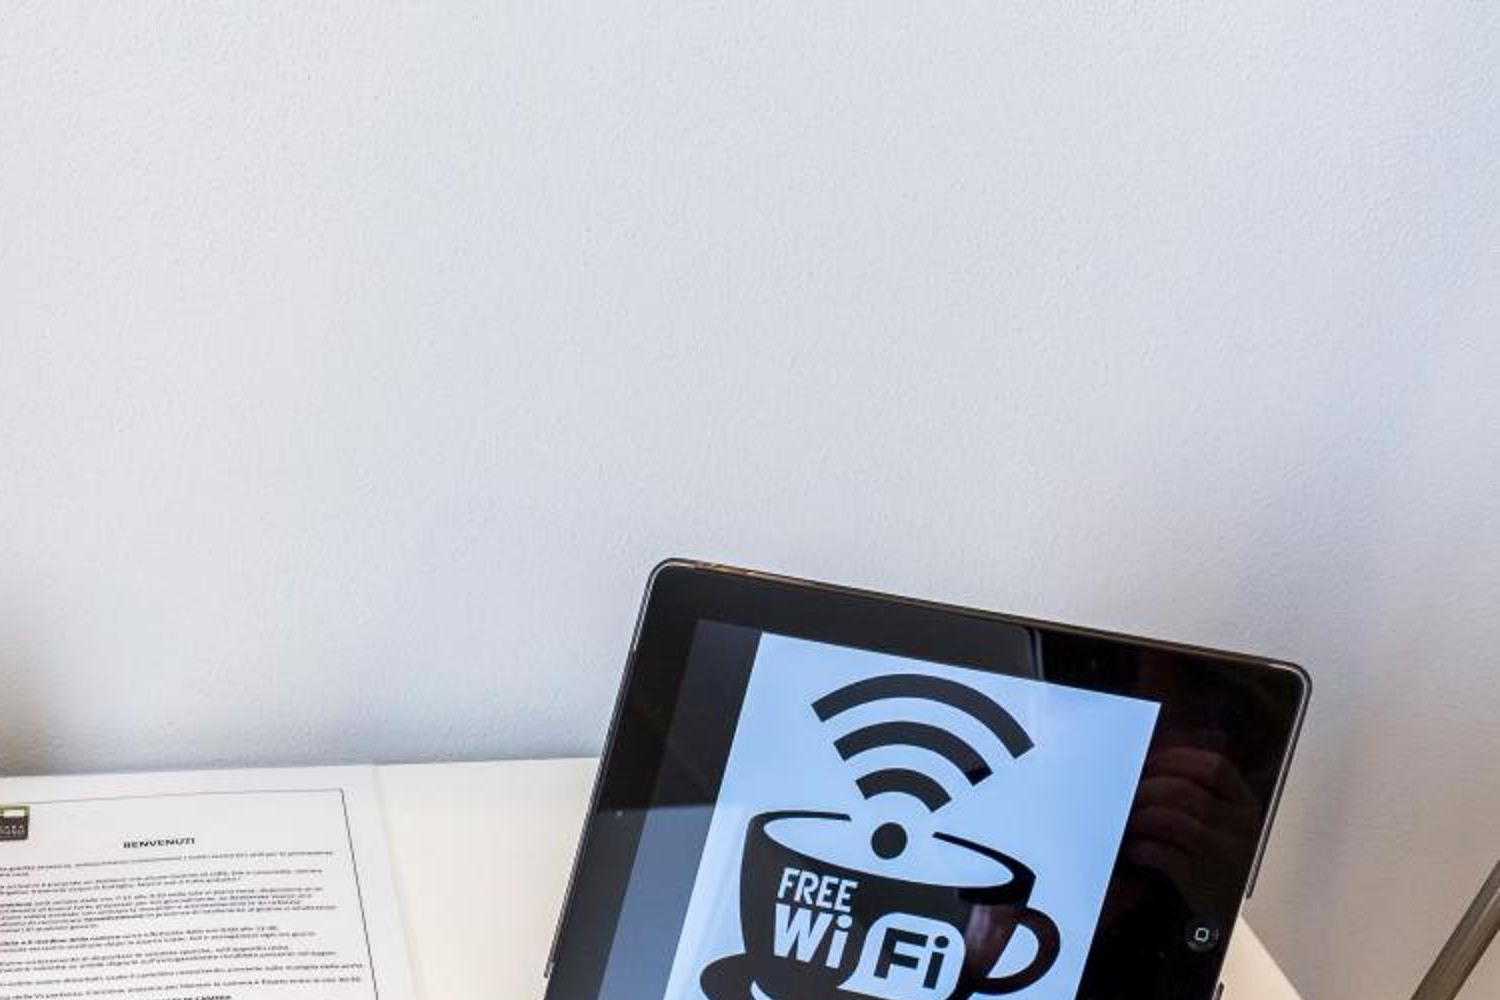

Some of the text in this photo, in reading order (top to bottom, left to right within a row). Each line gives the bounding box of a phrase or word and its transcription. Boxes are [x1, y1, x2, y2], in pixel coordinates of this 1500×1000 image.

[123, 837, 195, 849] BENVENUTI
[777, 867, 859, 911] FREE
[774, 904, 949, 990] Wi Fi
